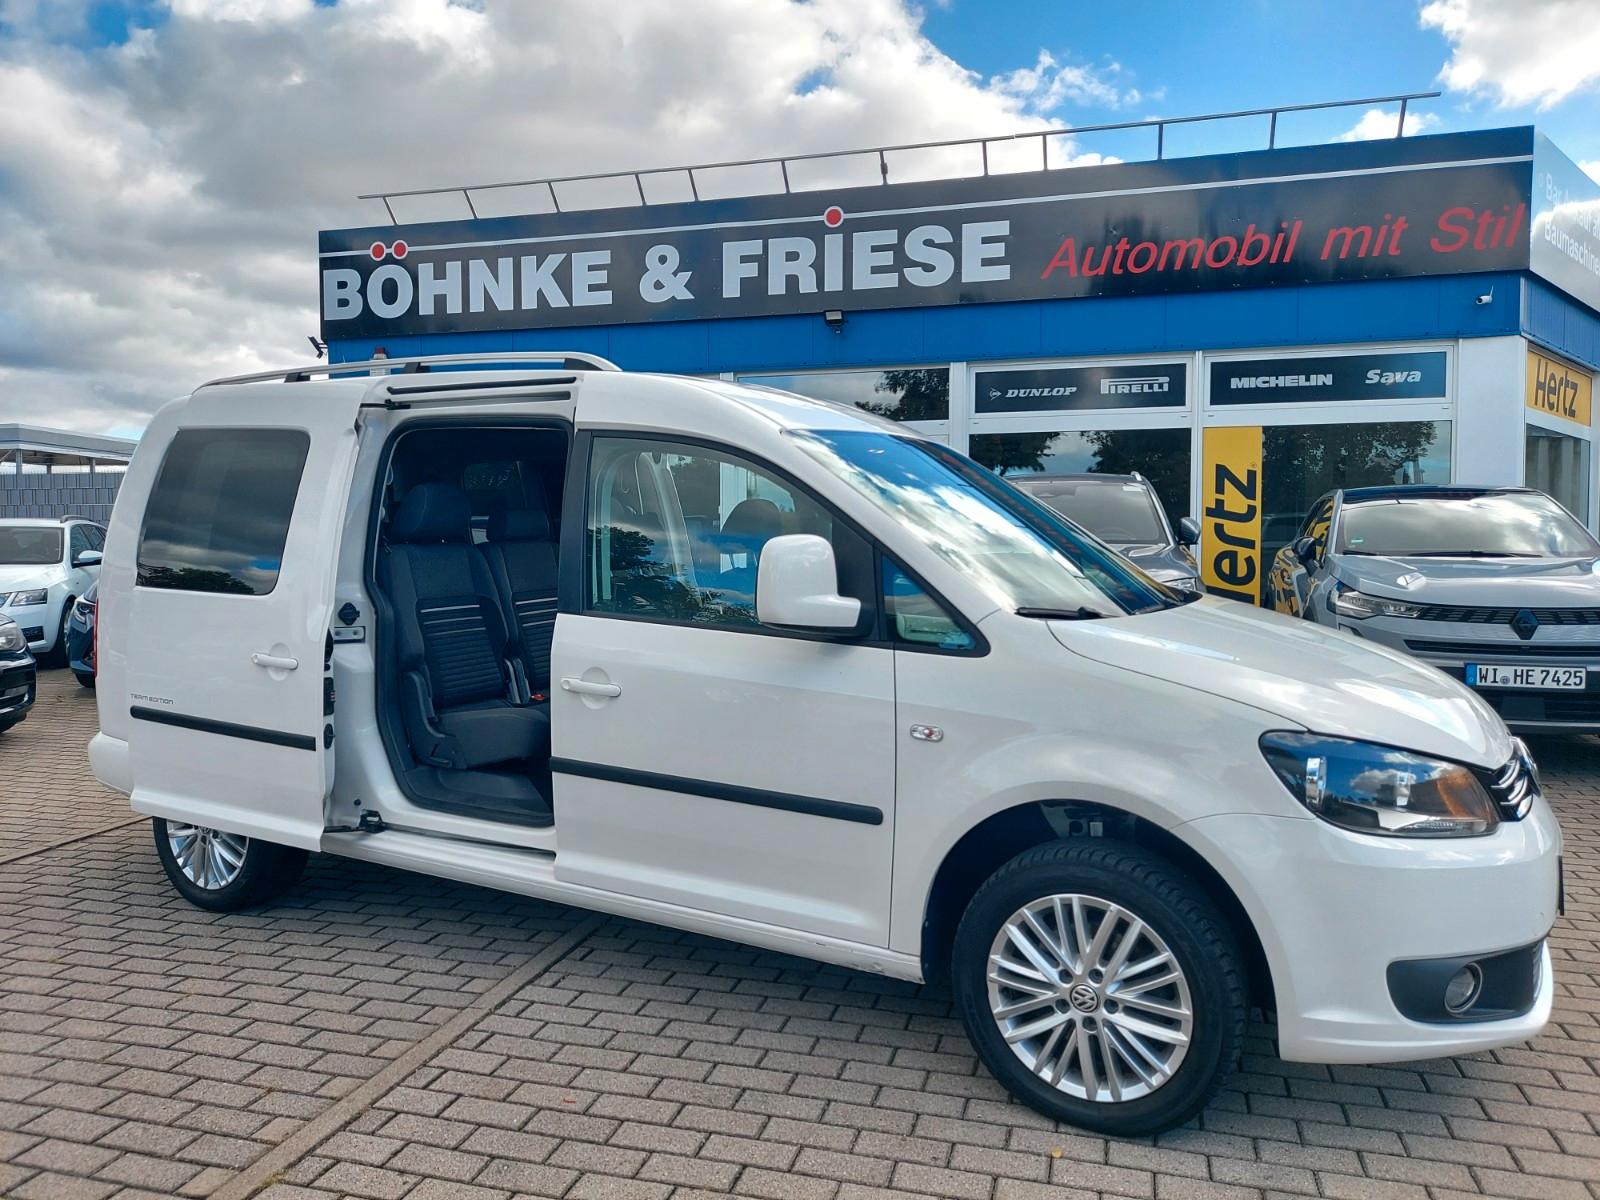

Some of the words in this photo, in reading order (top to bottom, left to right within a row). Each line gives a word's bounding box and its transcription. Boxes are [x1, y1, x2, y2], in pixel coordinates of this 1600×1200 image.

[1041, 220, 1303, 280] Automobil
[1320, 213, 1408, 260] mit
[1430, 202, 1526, 254] Stil
[323, 241, 613, 321] BÖHNKE
[639, 244, 695, 303] &
[722, 206, 1011, 298] FRIESE
[1100, 376, 1170, 394] PIRELLI
[1230, 373, 1333, 389] MICHELIN
[1365, 369, 1422, 386] Sava
[1005, 386, 1077, 398] DUNLOP
[1534, 358, 1579, 418] Hertz
[1478, 668, 1498, 683] WI
[1513, 669, 1536, 685] HE
[1540, 670, 1583, 686] 7425
